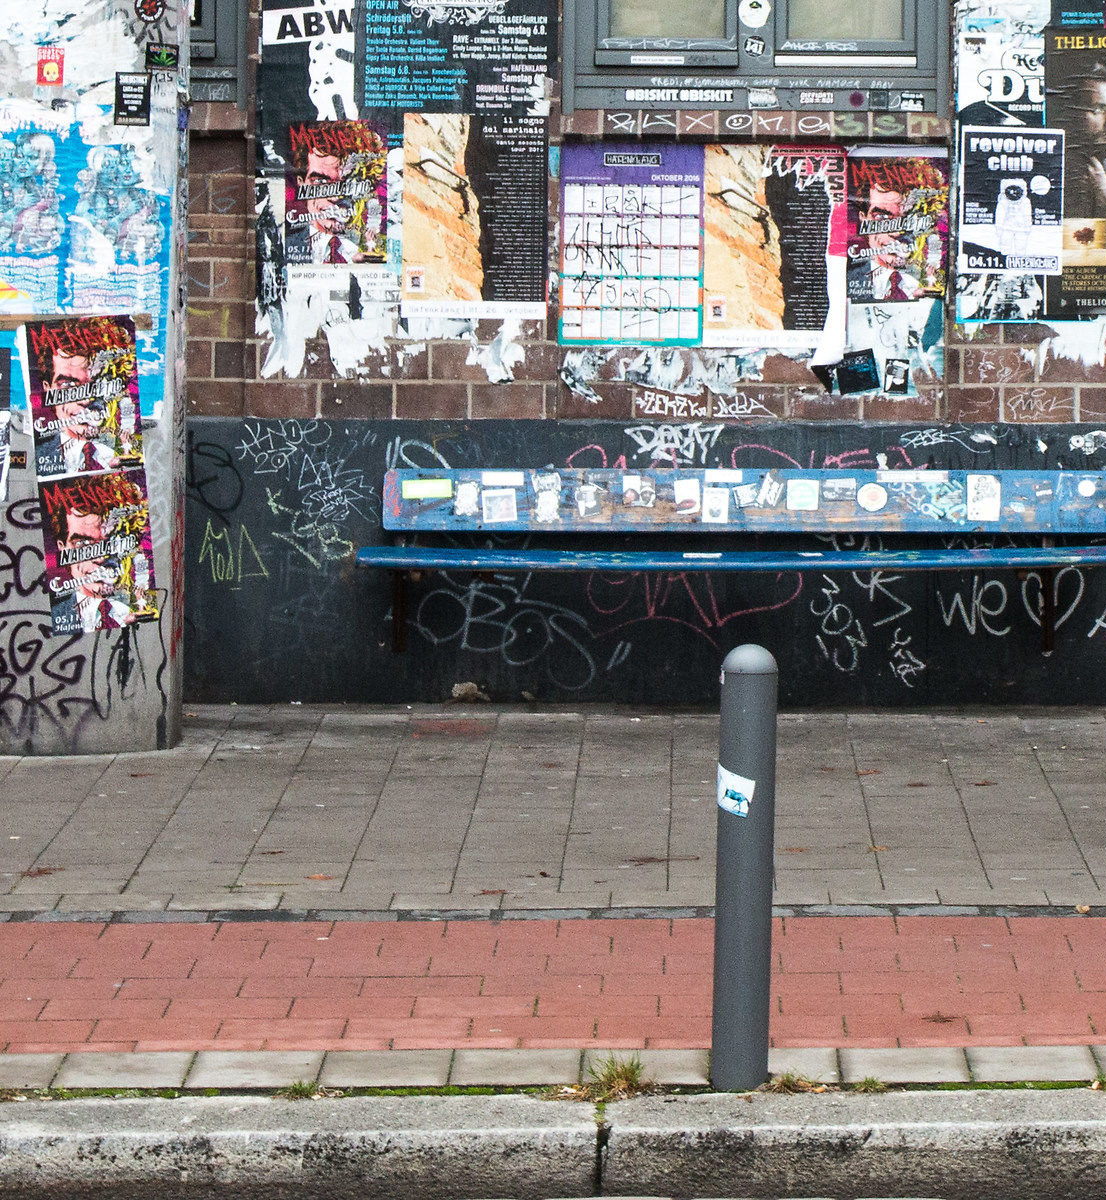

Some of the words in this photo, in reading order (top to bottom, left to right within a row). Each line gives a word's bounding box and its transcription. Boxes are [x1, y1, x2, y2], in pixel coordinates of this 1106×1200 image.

[366, 0, 385, 10] OPEN
[386, 0, 399, 10] AIR
[366, 13, 412, 23] Schröderstift
[366, 25, 391, 36] Freitag
[392, 25, 405, 34] 5.8.
[498, 25, 531, 37] Samstag
[533, 25, 547, 35] 6.8.
[1055, 36, 1086, 49] THE
[365, 65, 396, 76] Samstag
[397, 65, 411, 75] 6.8.
[501, 73, 533, 84] Samstag
[518, 117, 545, 126] sogno
[970, 135, 1057, 154] revolver
[987, 154, 1034, 171] club
[968, 256, 1004, 268] 04.11.
